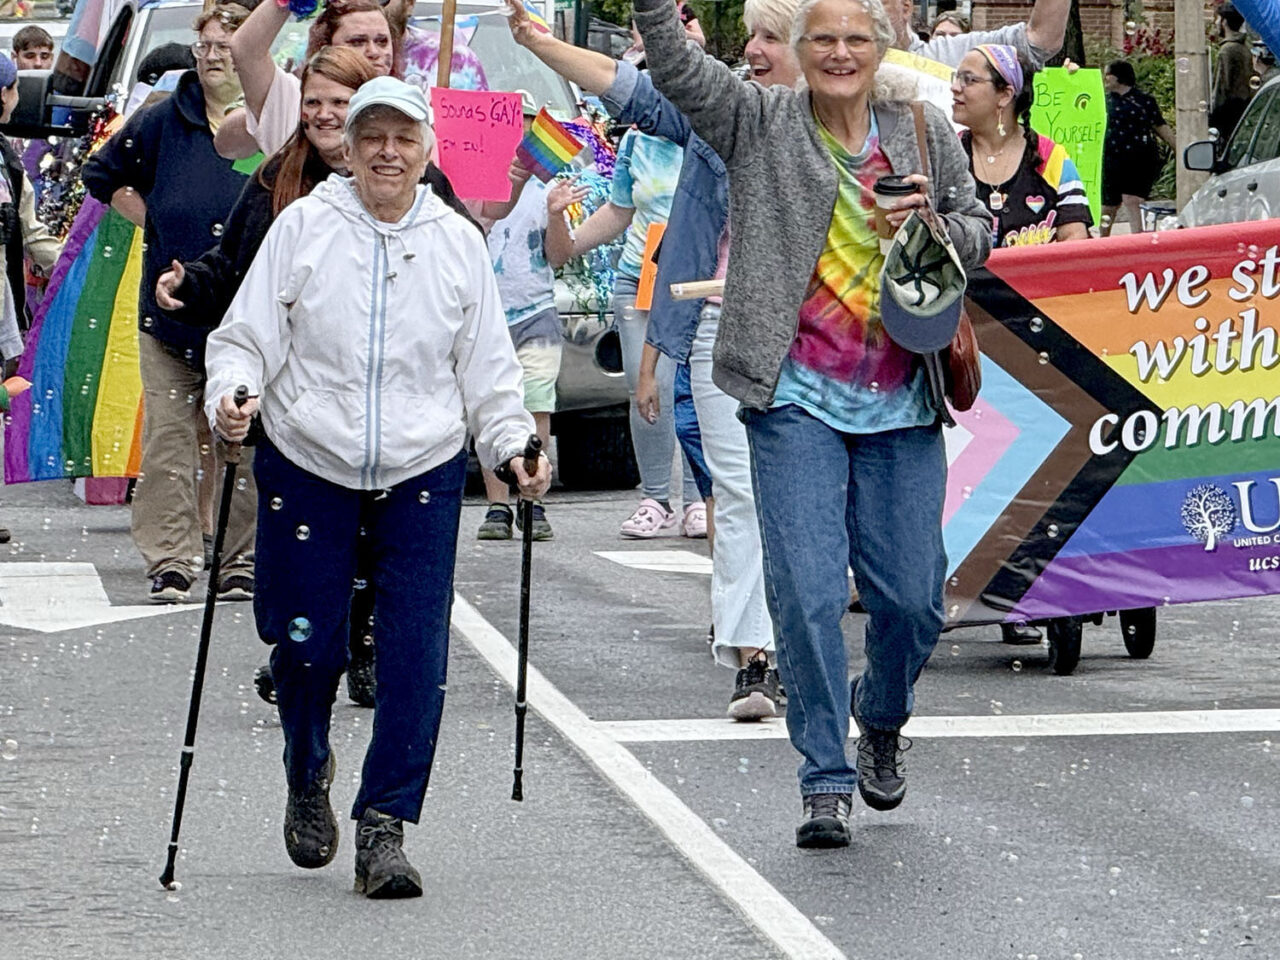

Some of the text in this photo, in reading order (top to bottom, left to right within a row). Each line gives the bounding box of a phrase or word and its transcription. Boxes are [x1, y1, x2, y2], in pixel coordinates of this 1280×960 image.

[1035, 83, 1065, 108] BE
[1045, 111, 1102, 144] YOURSELF
[1119, 263, 1212, 314] we
[1130, 308, 1280, 383] with
[1233, 536, 1271, 548] UNITED
